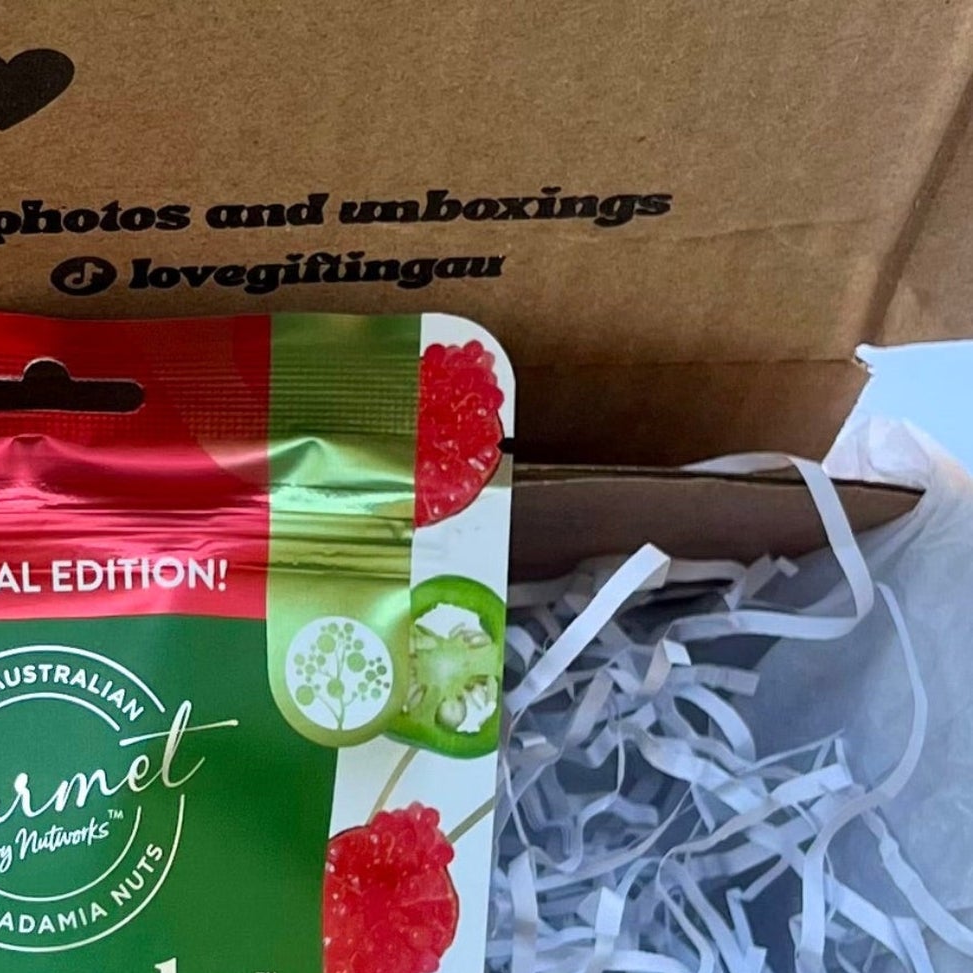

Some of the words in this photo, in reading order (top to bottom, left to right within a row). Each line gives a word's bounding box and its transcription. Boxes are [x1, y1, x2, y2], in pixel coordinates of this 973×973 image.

[205, 193, 329, 229] and
[338, 186, 673, 227] unboxings
[128, 251, 507, 294] lovegiftingau
[51, 556, 229, 592] EDITION!
[110, 842, 163, 907] NUTS
